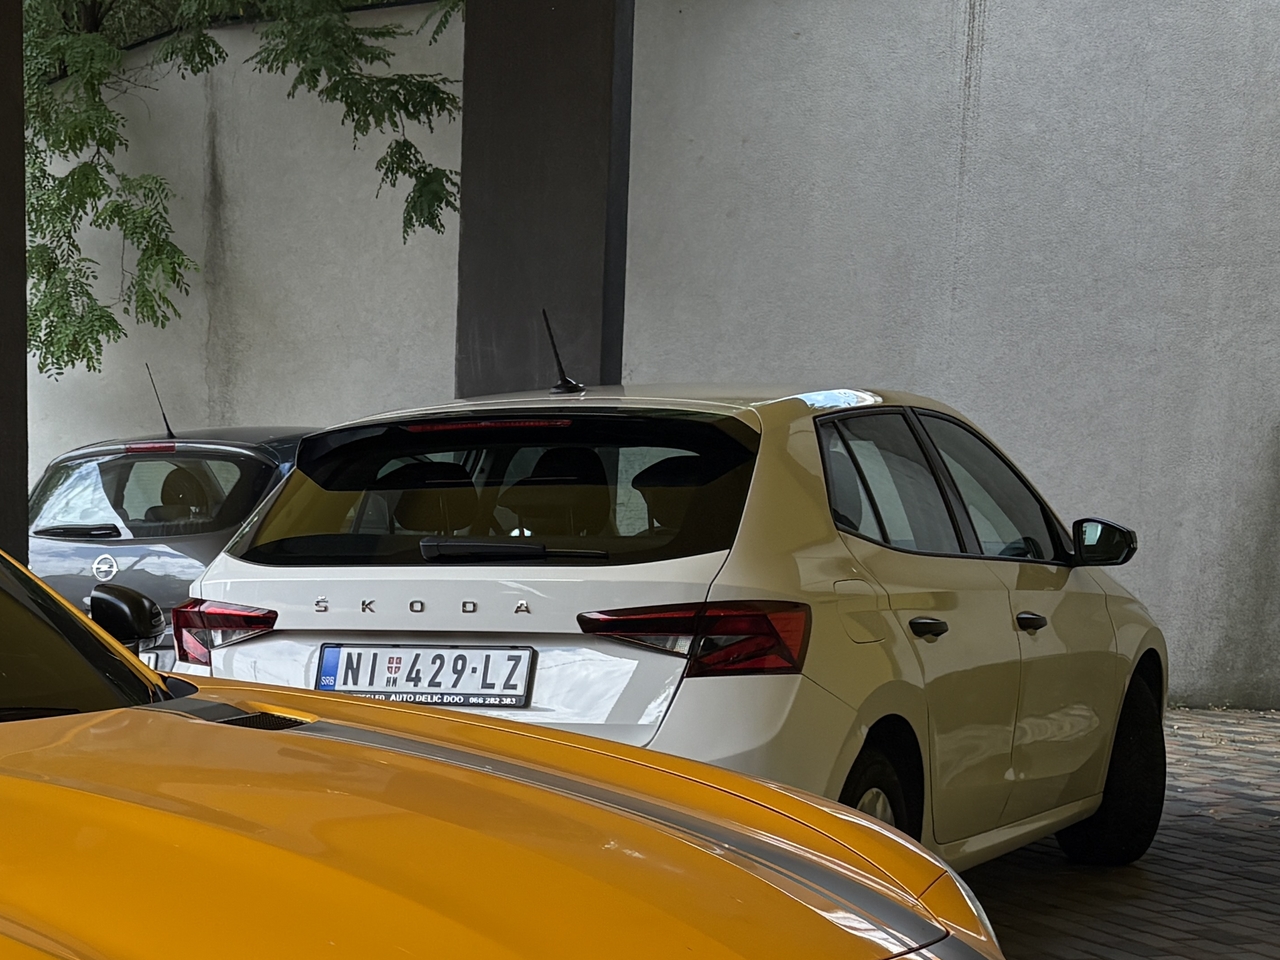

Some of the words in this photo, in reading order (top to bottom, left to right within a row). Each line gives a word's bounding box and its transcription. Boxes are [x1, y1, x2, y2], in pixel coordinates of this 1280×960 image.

[314, 595, 532, 614] ŠKODA
[343, 652, 378, 687] NI
[320, 676, 335, 686] SRB
[389, 693, 414, 702] AUTO
[443, 695, 464, 703] DOO
